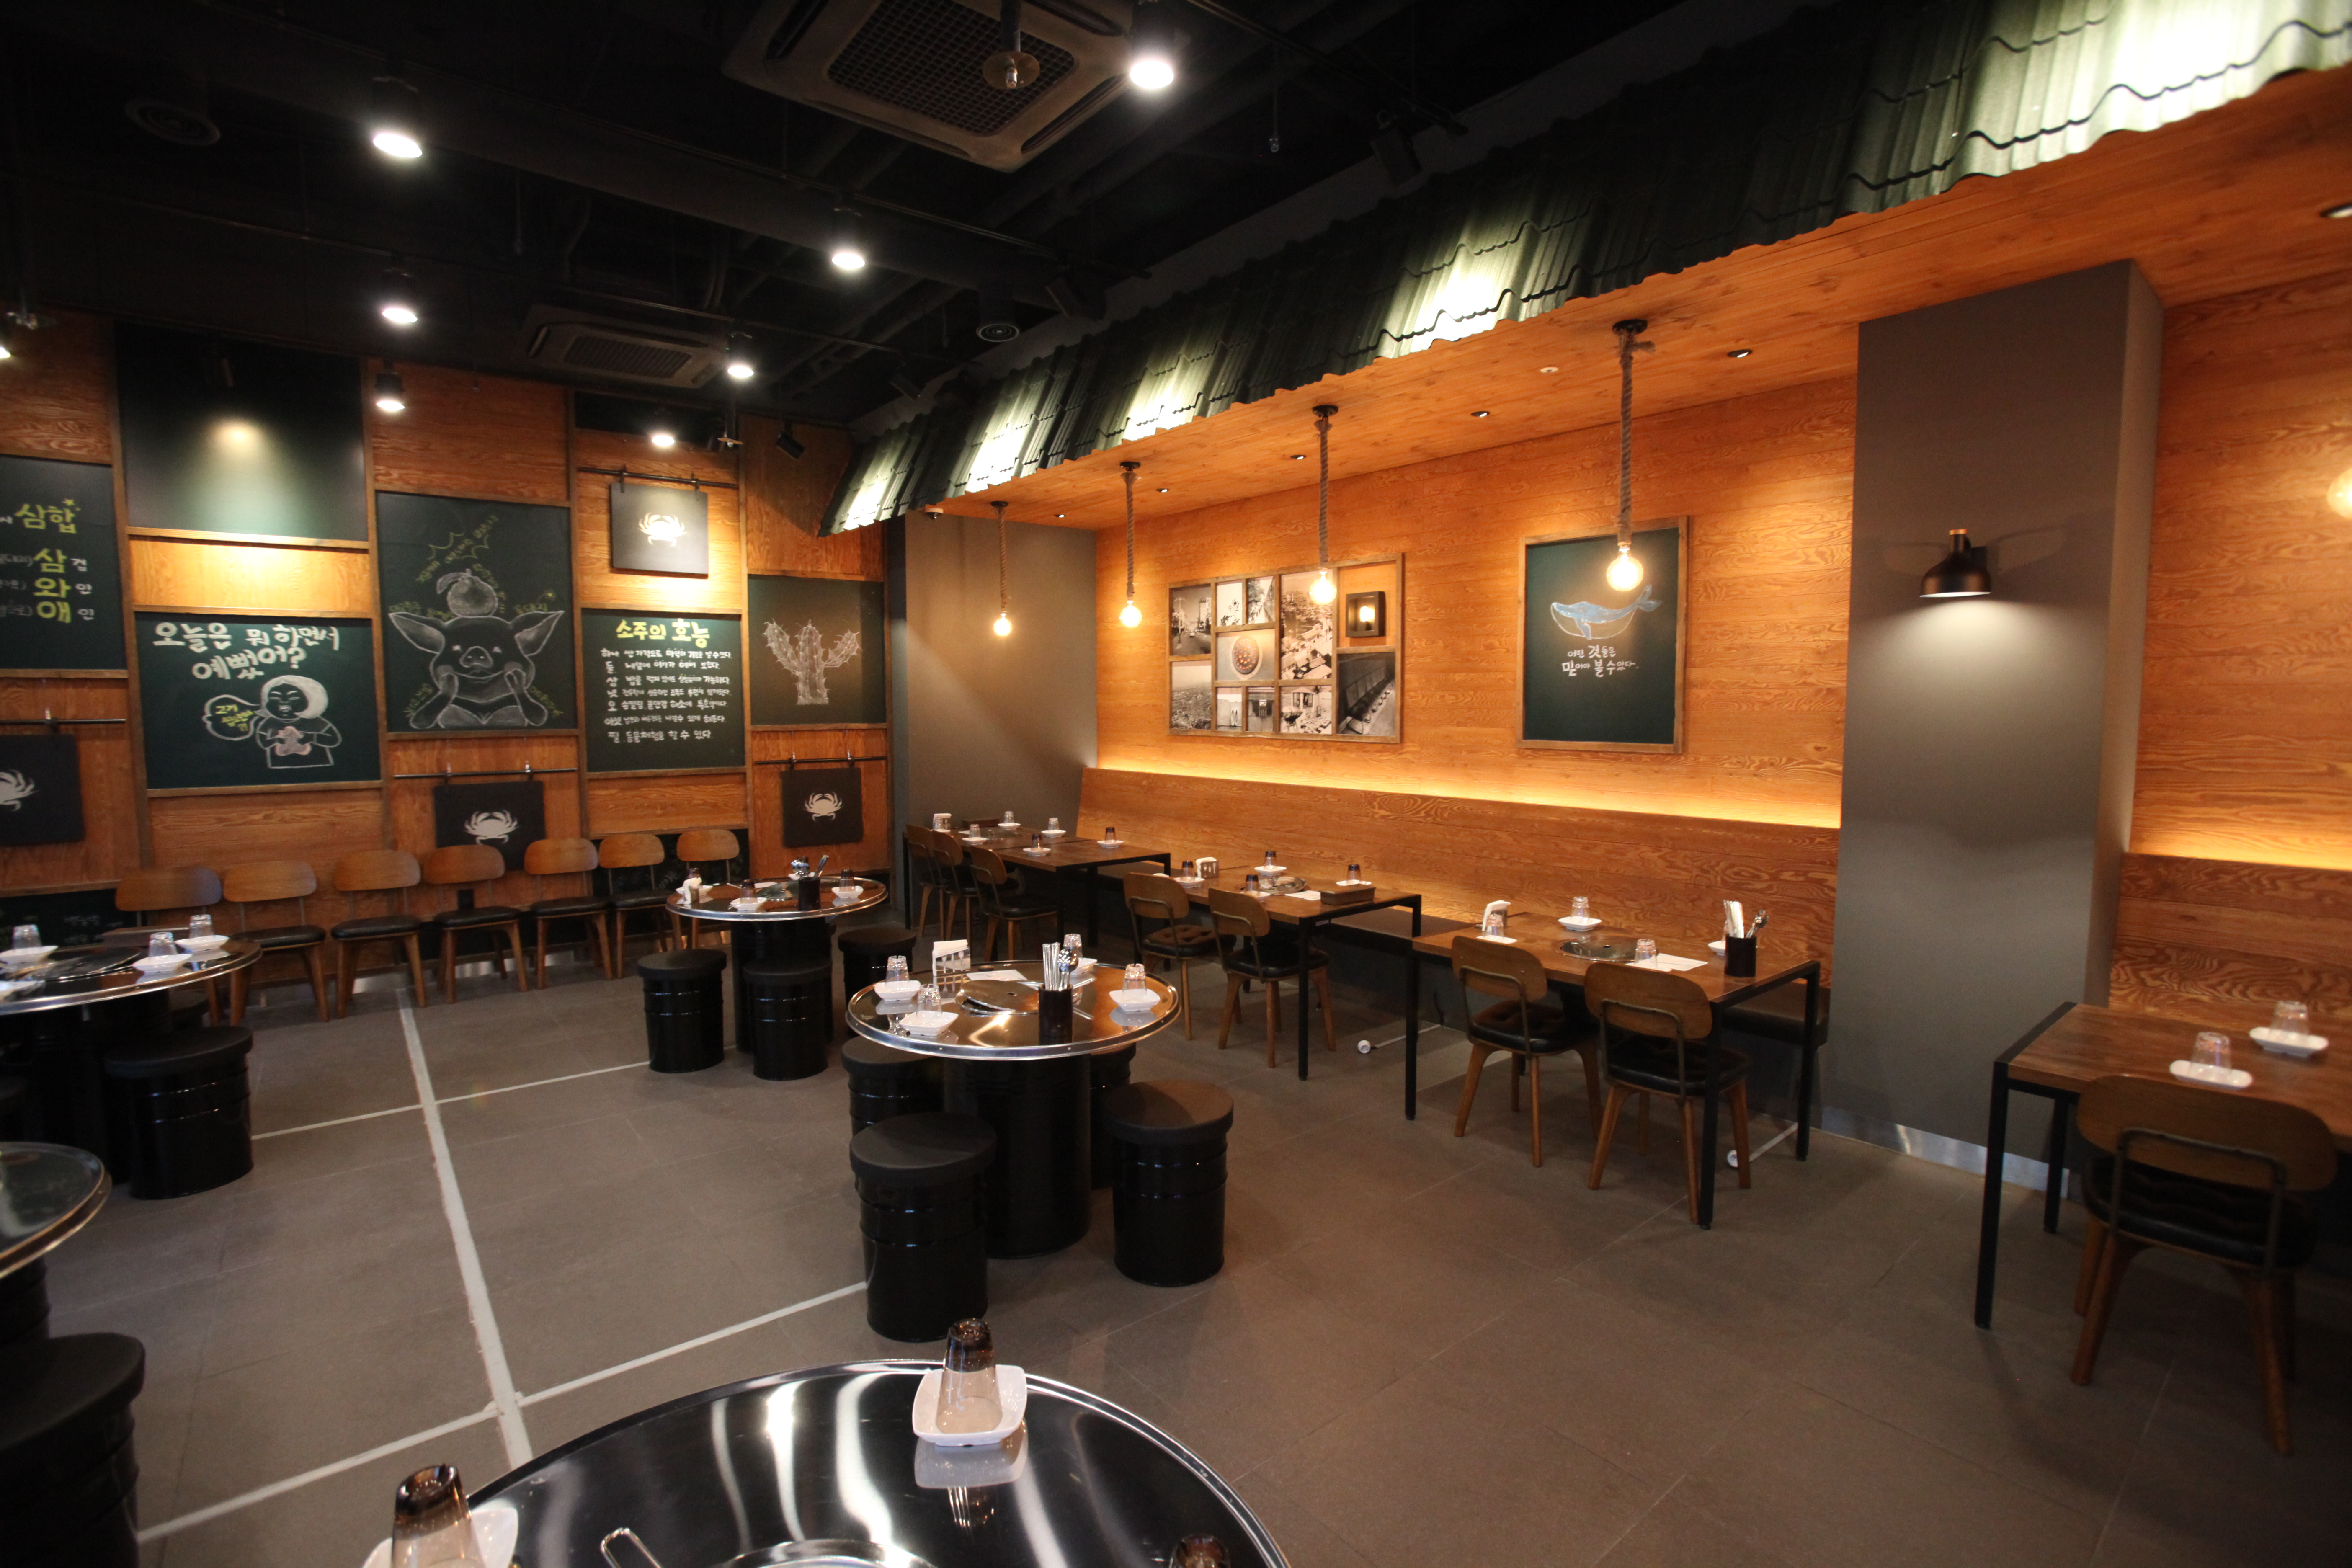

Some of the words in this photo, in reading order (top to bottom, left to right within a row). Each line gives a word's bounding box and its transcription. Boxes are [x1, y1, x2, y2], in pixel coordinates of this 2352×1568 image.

[152, 622, 232, 653] 오늘은
[616, 619, 667, 640] 소주의
[671, 618, 710, 648] 효능
[601, 647, 620, 657] 하나
[1567, 649, 1586, 659] 어떤
[1588, 645, 1617, 659] 것들은
[191, 645, 307, 679] 예뻤어?
[1561, 660, 1591, 677] 믿어야
[1594, 659, 1604, 678] 볼
[680, 730, 690, 740] 수
